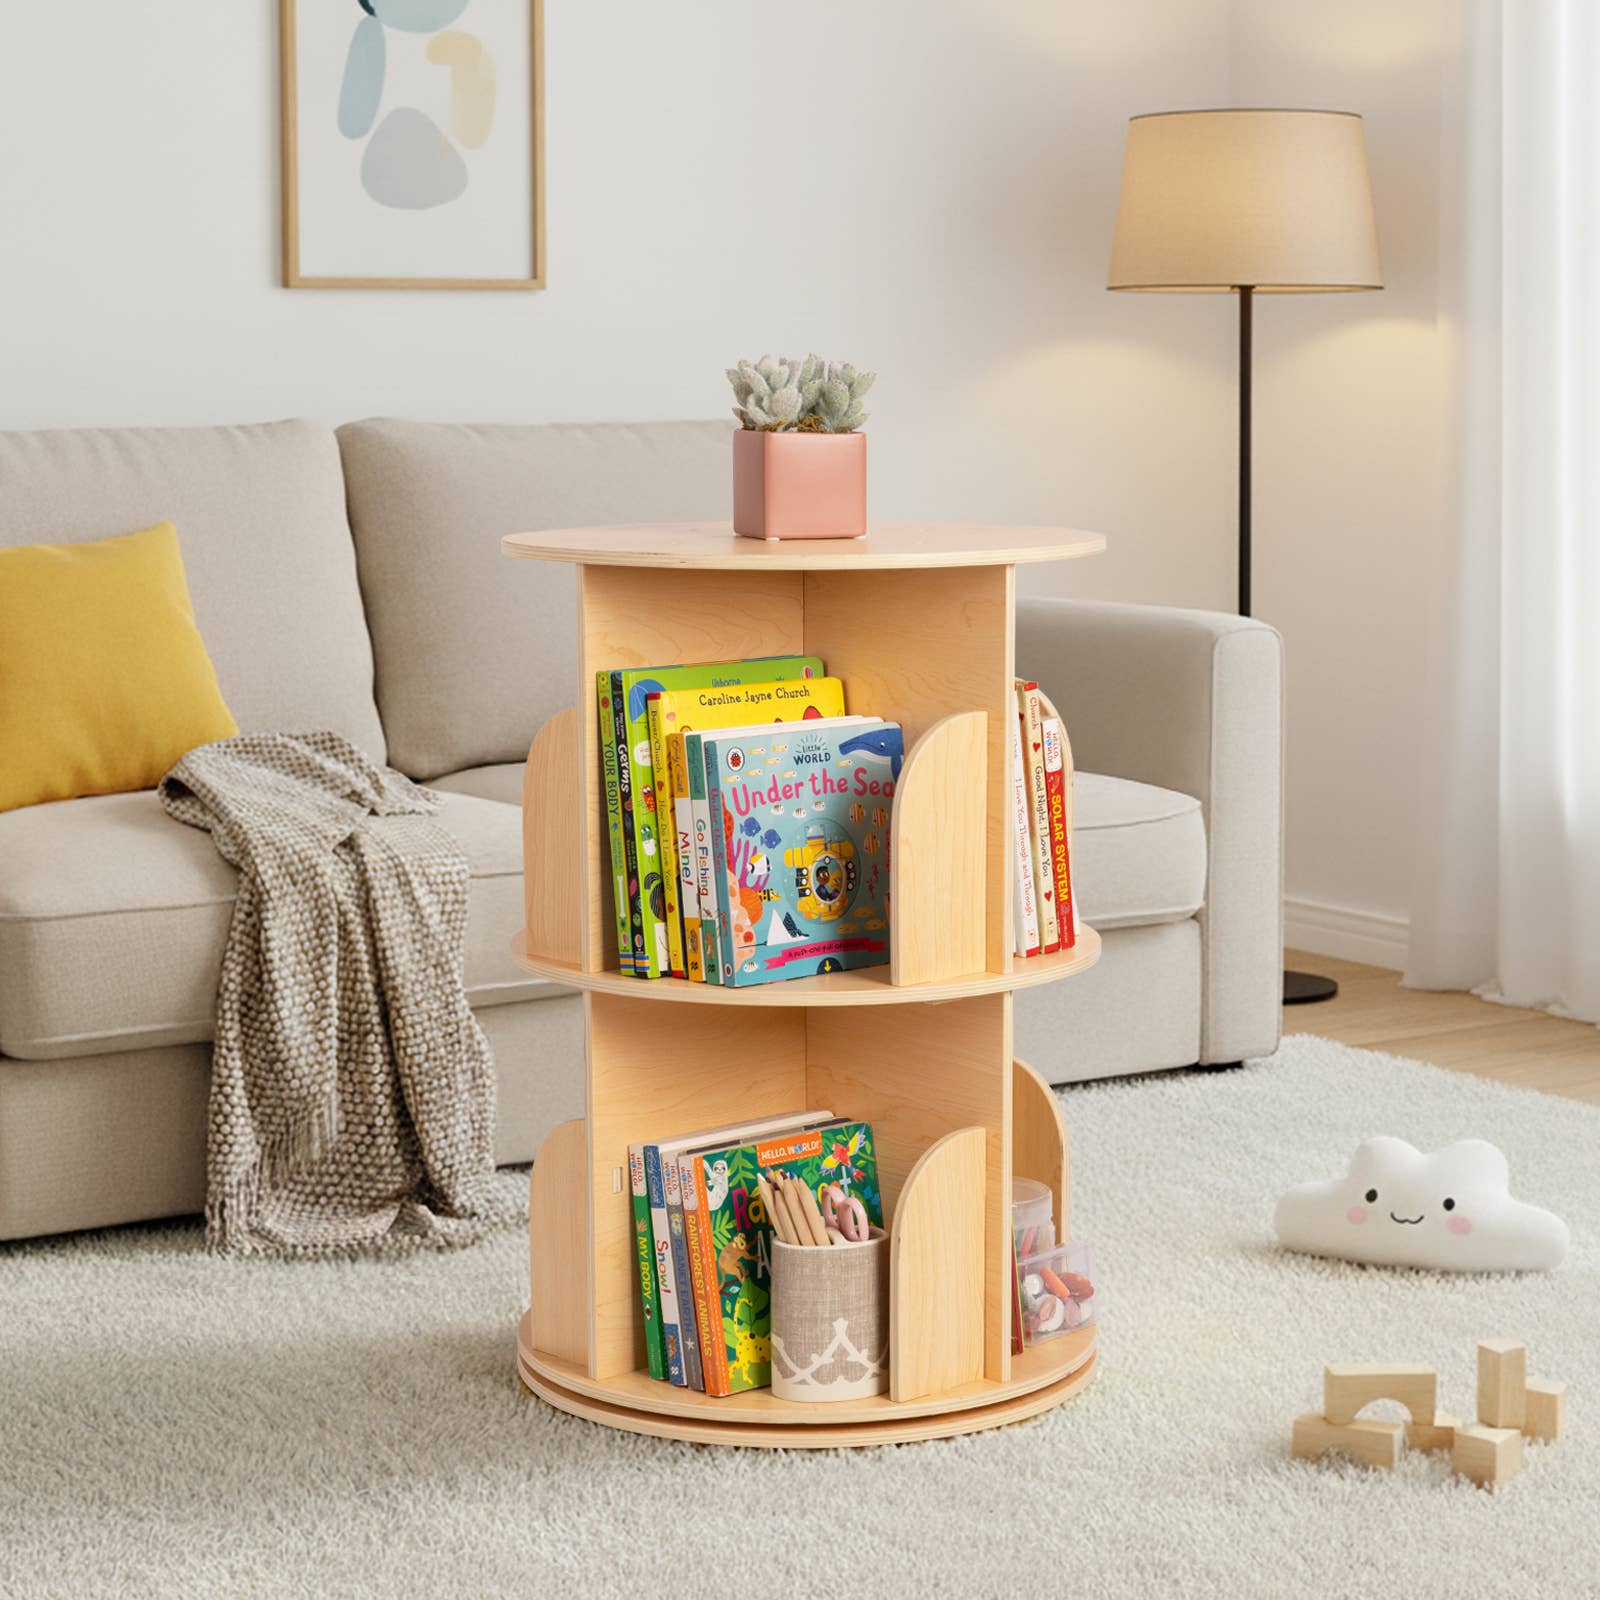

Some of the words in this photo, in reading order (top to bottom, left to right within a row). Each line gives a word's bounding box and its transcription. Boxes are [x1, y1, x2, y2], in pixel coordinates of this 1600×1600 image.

[698, 692, 741, 706] Caroline
[745, 690, 772, 704] Jayne
[775, 685, 811, 699] Church
[1030, 697, 1039, 730] Church
[604, 741, 616, 776] YOUR
[793, 751, 831, 766] WORLD
[801, 744, 822, 753] little
[618, 744, 629, 793] Germs
[1035, 766, 1044, 792] Good
[606, 780, 619, 815] BODY
[711, 787, 720, 824] Under
[731, 773, 804, 817] Under
[808, 767, 849, 796] the
[853, 767, 894, 798] Sea
[696, 818, 706, 842] Go
[1051, 794, 1064, 841] SOLAR
[713, 828, 721, 848] the
[1040, 834, 1049, 857] Love
[678, 831, 694, 886] Mine!
[698, 847, 710, 896] Fishing
[715, 851, 723, 873] Sea
[1042, 858, 1051, 877] You
[1055, 844, 1069, 902] SYSTEM
[761, 1147, 787, 1160] HELLO,
[638, 1236, 649, 1259] MY
[675, 1238, 688, 1287] PLANET
[641, 1261, 652, 1300] BODY
[656, 1239, 672, 1294] Snow!
[688, 1214, 705, 1295] RAINFOREST
[698, 1298, 712, 1358] ANIMALS
[680, 1290, 692, 1334] EARTH
